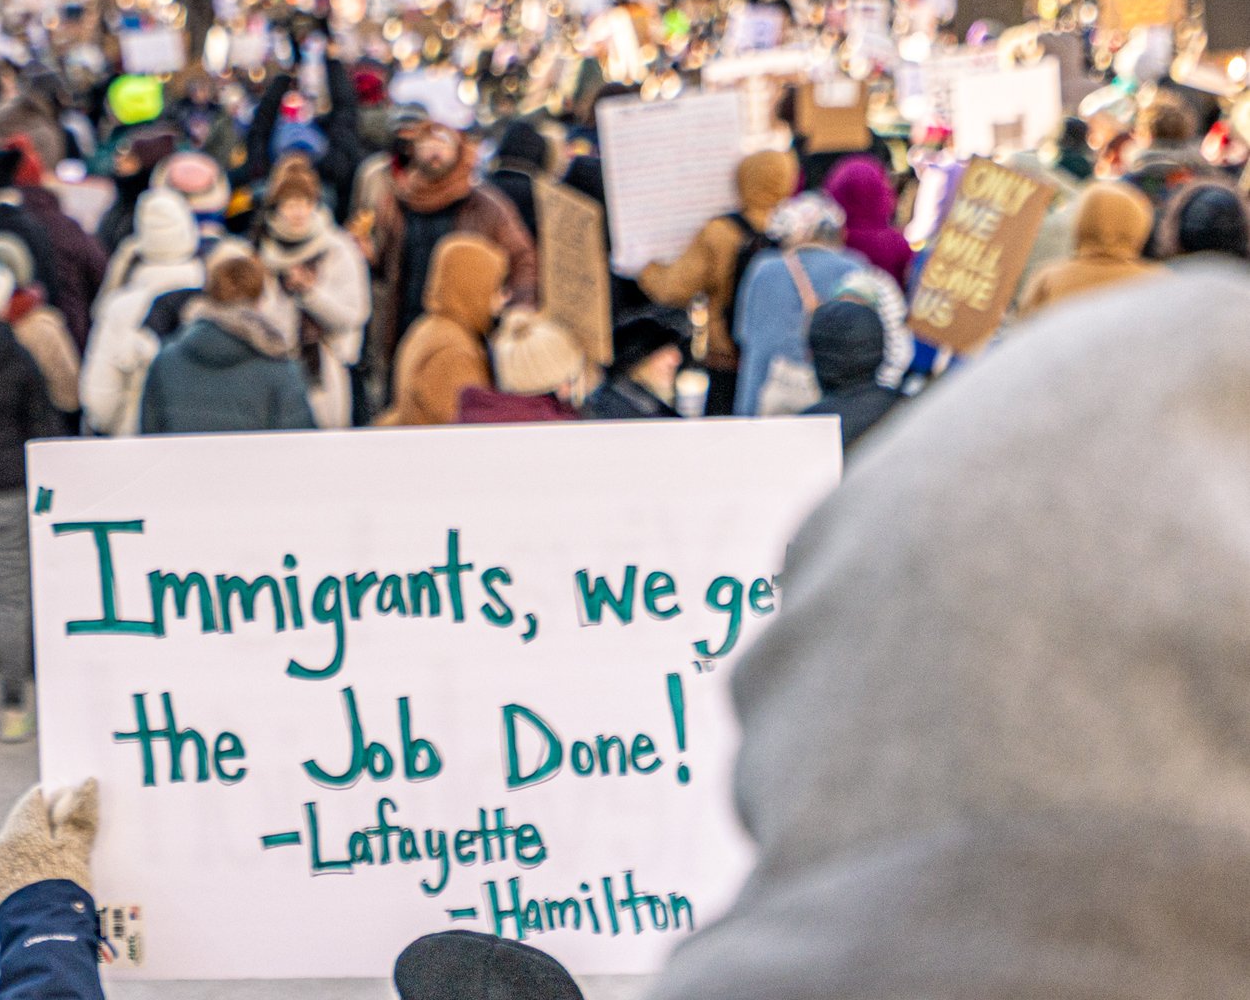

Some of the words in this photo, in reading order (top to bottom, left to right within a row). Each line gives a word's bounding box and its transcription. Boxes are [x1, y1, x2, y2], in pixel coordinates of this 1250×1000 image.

[953, 199, 1003, 240] WE
[939, 228, 1003, 280] WILL
[912, 286, 955, 329] US
[576, 564, 682, 624] we
[693, 575, 780, 658] ge
[114, 692, 246, 786] the
[303, 687, 442, 786] Job
